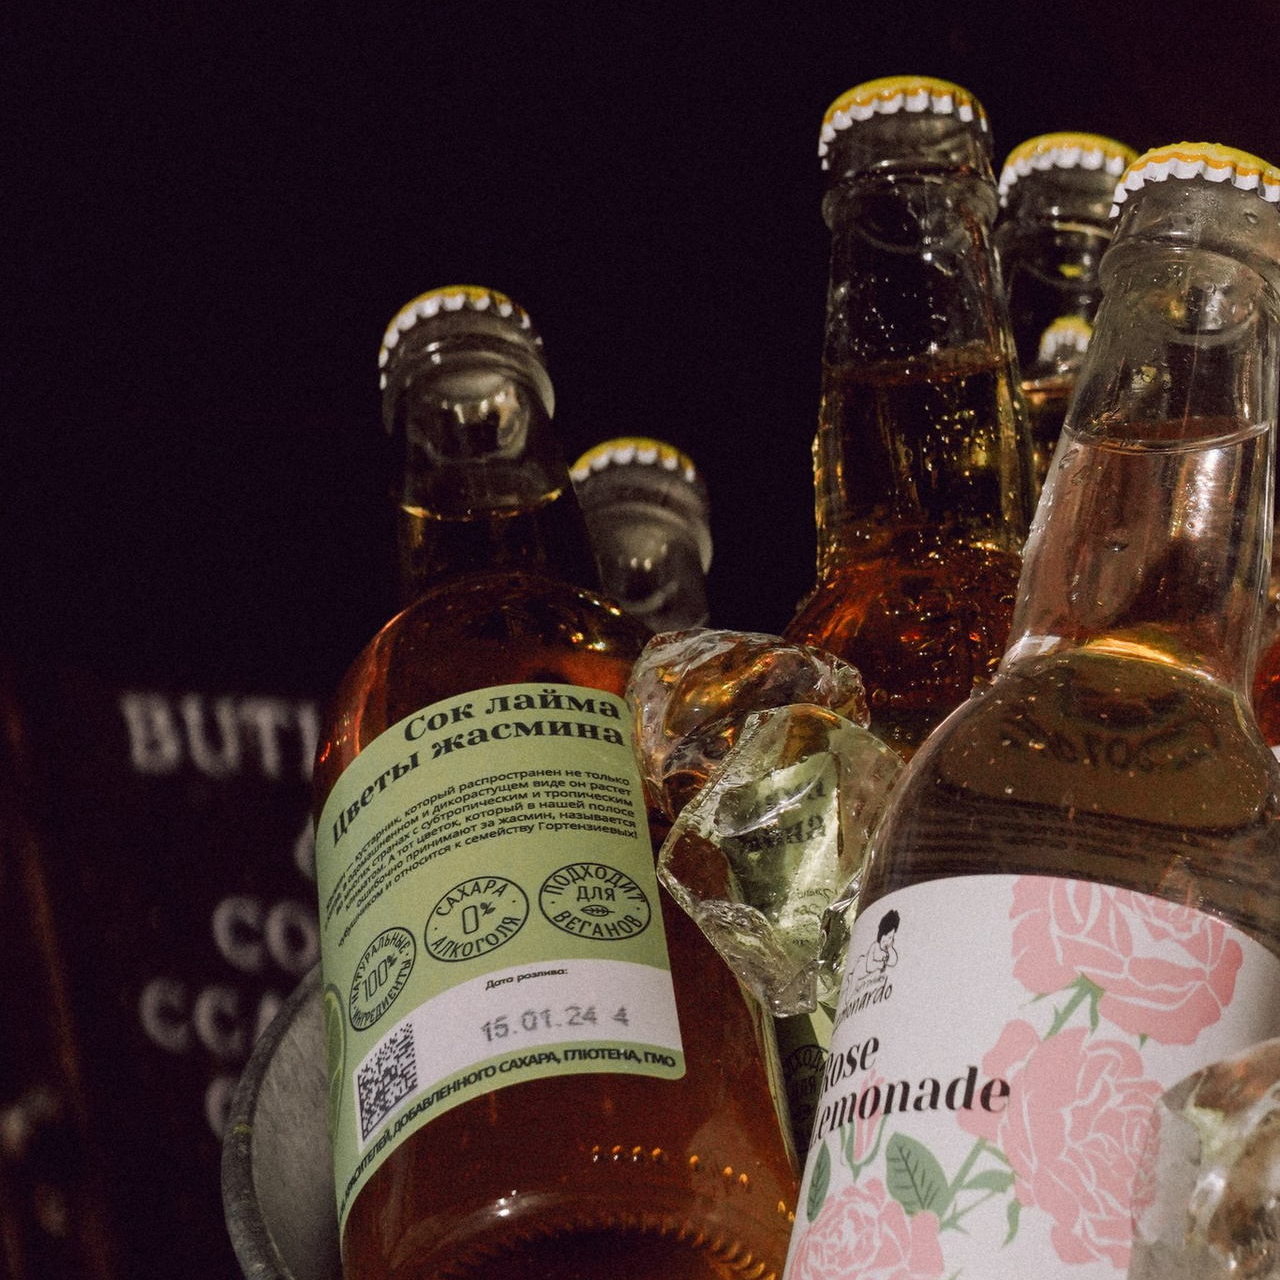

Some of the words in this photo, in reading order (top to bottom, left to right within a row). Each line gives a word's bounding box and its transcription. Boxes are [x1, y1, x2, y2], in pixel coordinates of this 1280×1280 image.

[405, 702, 475, 742] Сок
[485, 689, 621, 720] лайма
[331, 750, 420, 848] Цветы
[432, 719, 625, 759] жасмина
[404, 786, 456, 819] который
[459, 768, 561, 793] распространен
[565, 770, 582, 779] не
[585, 771, 630, 787] только
[422, 809, 430, 818] и
[432, 781, 529, 816] дикорастущем
[533, 779, 565, 790] виде
[569, 780, 586, 789] он
[590, 781, 632, 797] растет
[372, 834, 410, 871] странах
[412, 826, 419, 835] с
[421, 790, 529, 833] субтропическим
[544, 789, 633, 807] тропическим
[386, 881, 392, 890] и
[393, 843, 452, 883] относится
[454, 840, 462, 849] к
[464, 824, 534, 845] семейству
[538, 821, 638, 840] Гортензиевых!
[388, 854, 395, 865] А
[397, 841, 414, 856] тот
[416, 817, 461, 845] цветок,
[464, 800, 524, 823] который
[527, 801, 535, 810] в
[539, 799, 585, 811] нашей
[589, 802, 635, 818] полосе
[406, 823, 477, 863] принимают
[480, 819, 496, 829] за
[498, 810, 556, 826] жасмин,
[559, 810, 637, 829] называется
[435, 879, 509, 918] САХАРА
[543, 863, 647, 905] ПОДХОДИТ
[576, 885, 616, 903] ДЛЯ
[430, 914, 521, 959] АЛКОГОЛЯ
[554, 909, 644, 938] ВЕГАНОВ
[485, 976, 514, 991] Дата
[517, 967, 568, 984] розлива:
[480, 1004, 598, 1043] 15.01.24
[611, 1006, 630, 1027] 4
[392, 1064, 497, 1138] ДОБАВЛЕННОГО
[498, 1050, 563, 1073] САХАРА,
[564, 1047, 642, 1065] ГЛЮТЕНА,
[643, 1051, 676, 1068] ГМО
[812, 1065, 1011, 1143] emonade
